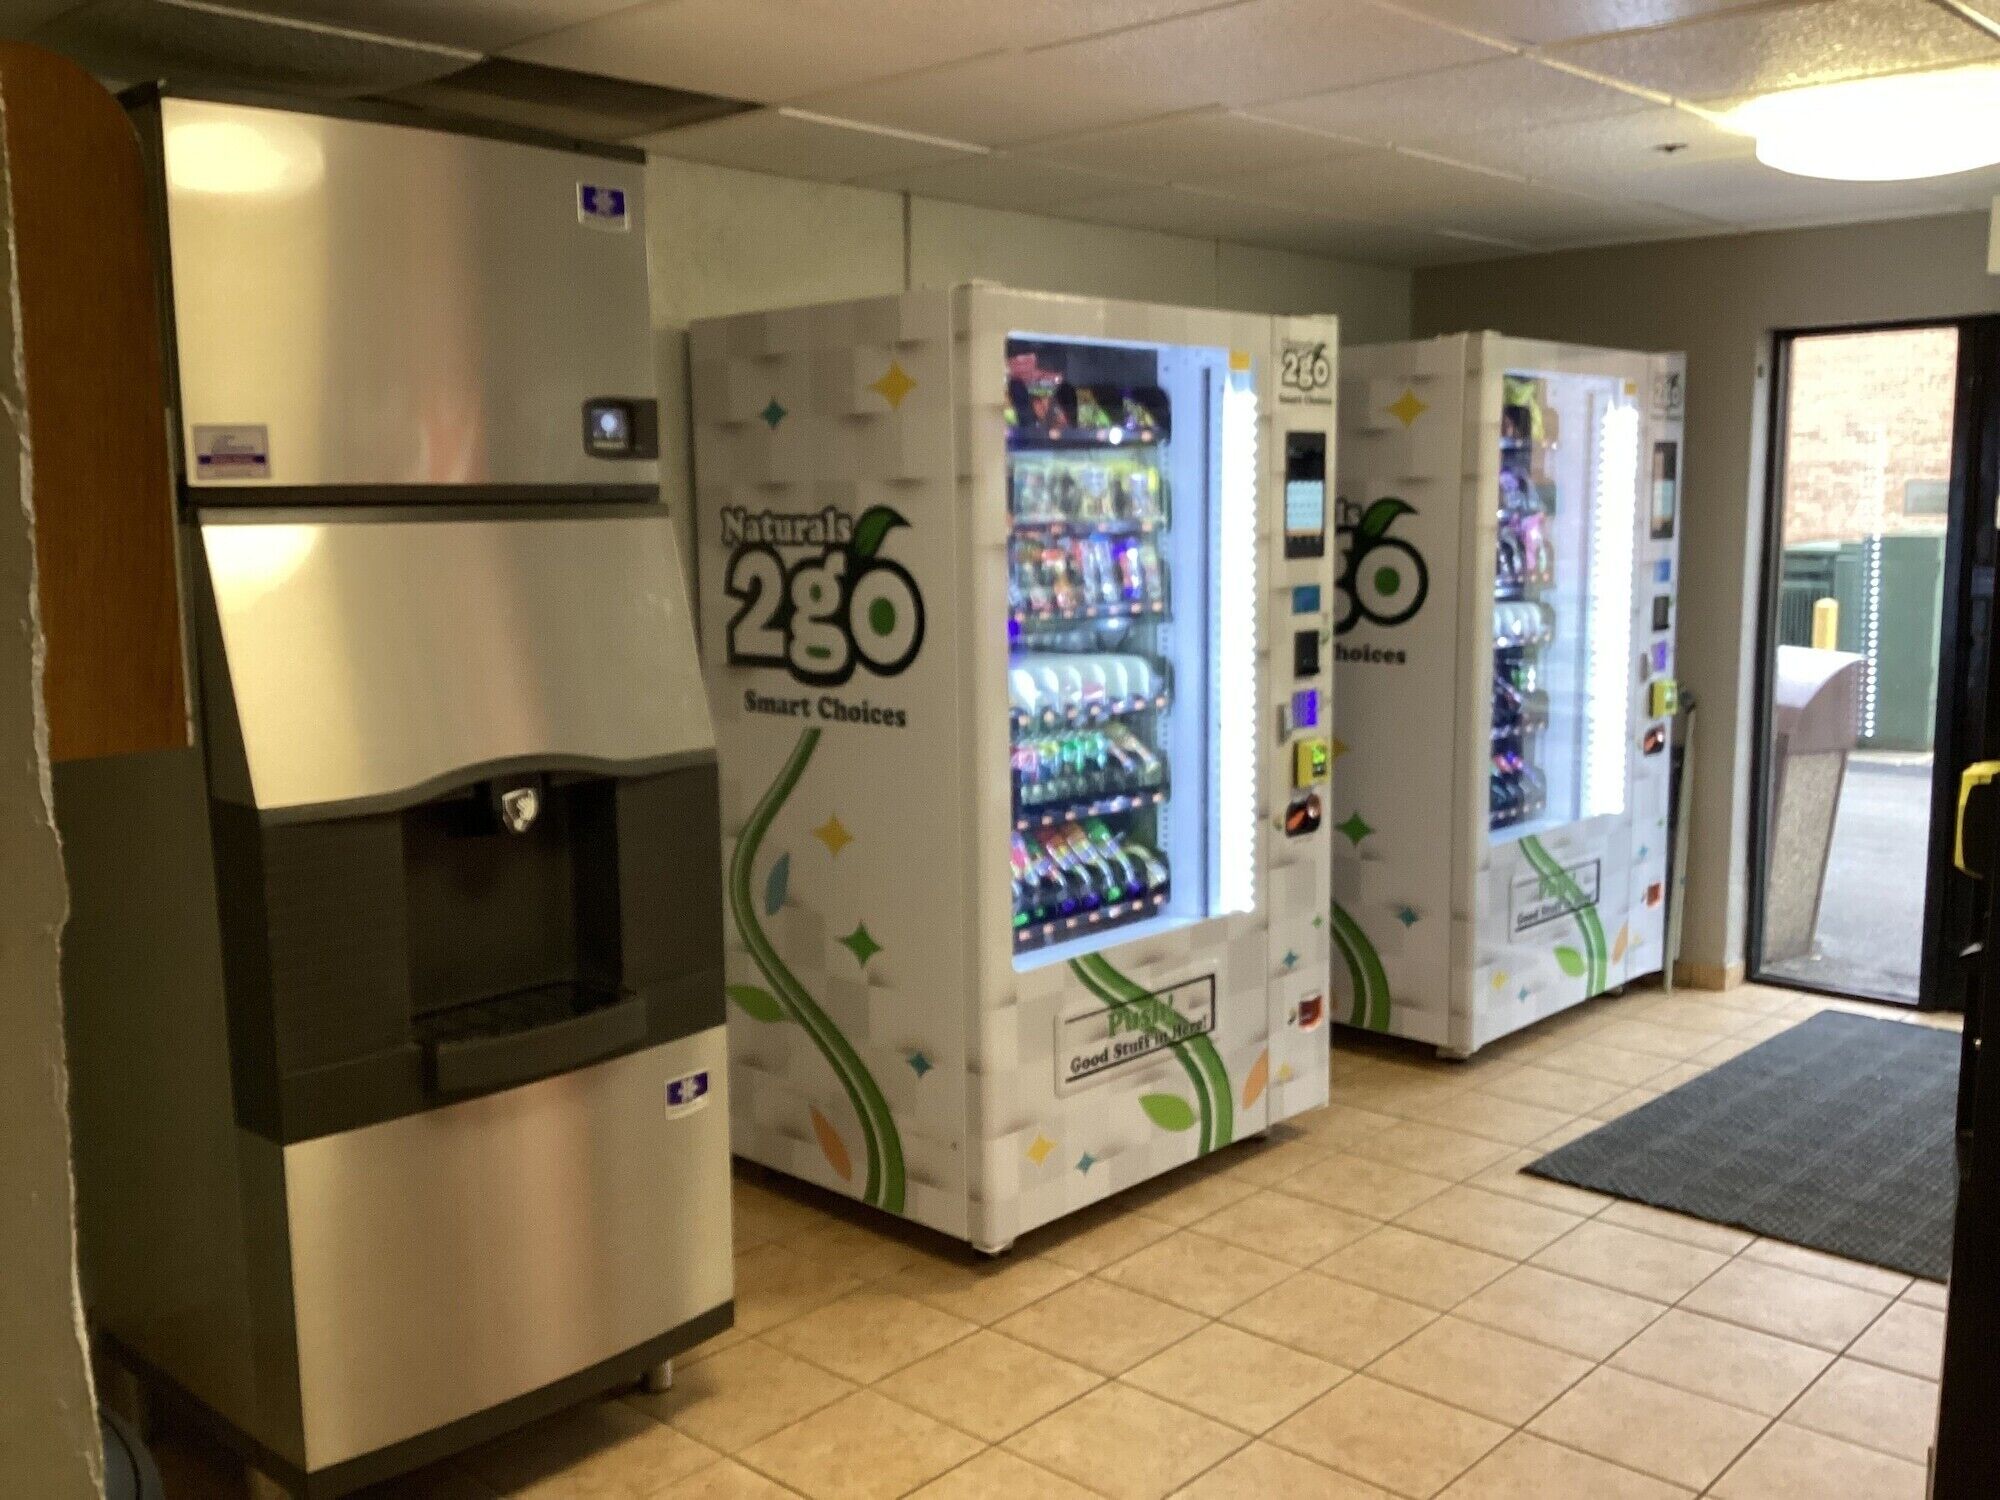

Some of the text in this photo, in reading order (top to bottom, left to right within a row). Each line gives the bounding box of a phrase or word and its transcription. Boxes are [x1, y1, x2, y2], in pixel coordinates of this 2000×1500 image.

[720, 505, 854, 547] Naturals
[724, 544, 925, 688] 2go
[1334, 644, 1406, 665] hoices
[744, 689, 907, 728] Smart Choices
[1070, 1047, 1109, 1074] Good
[1113, 1033, 1151, 1059] Stuff
